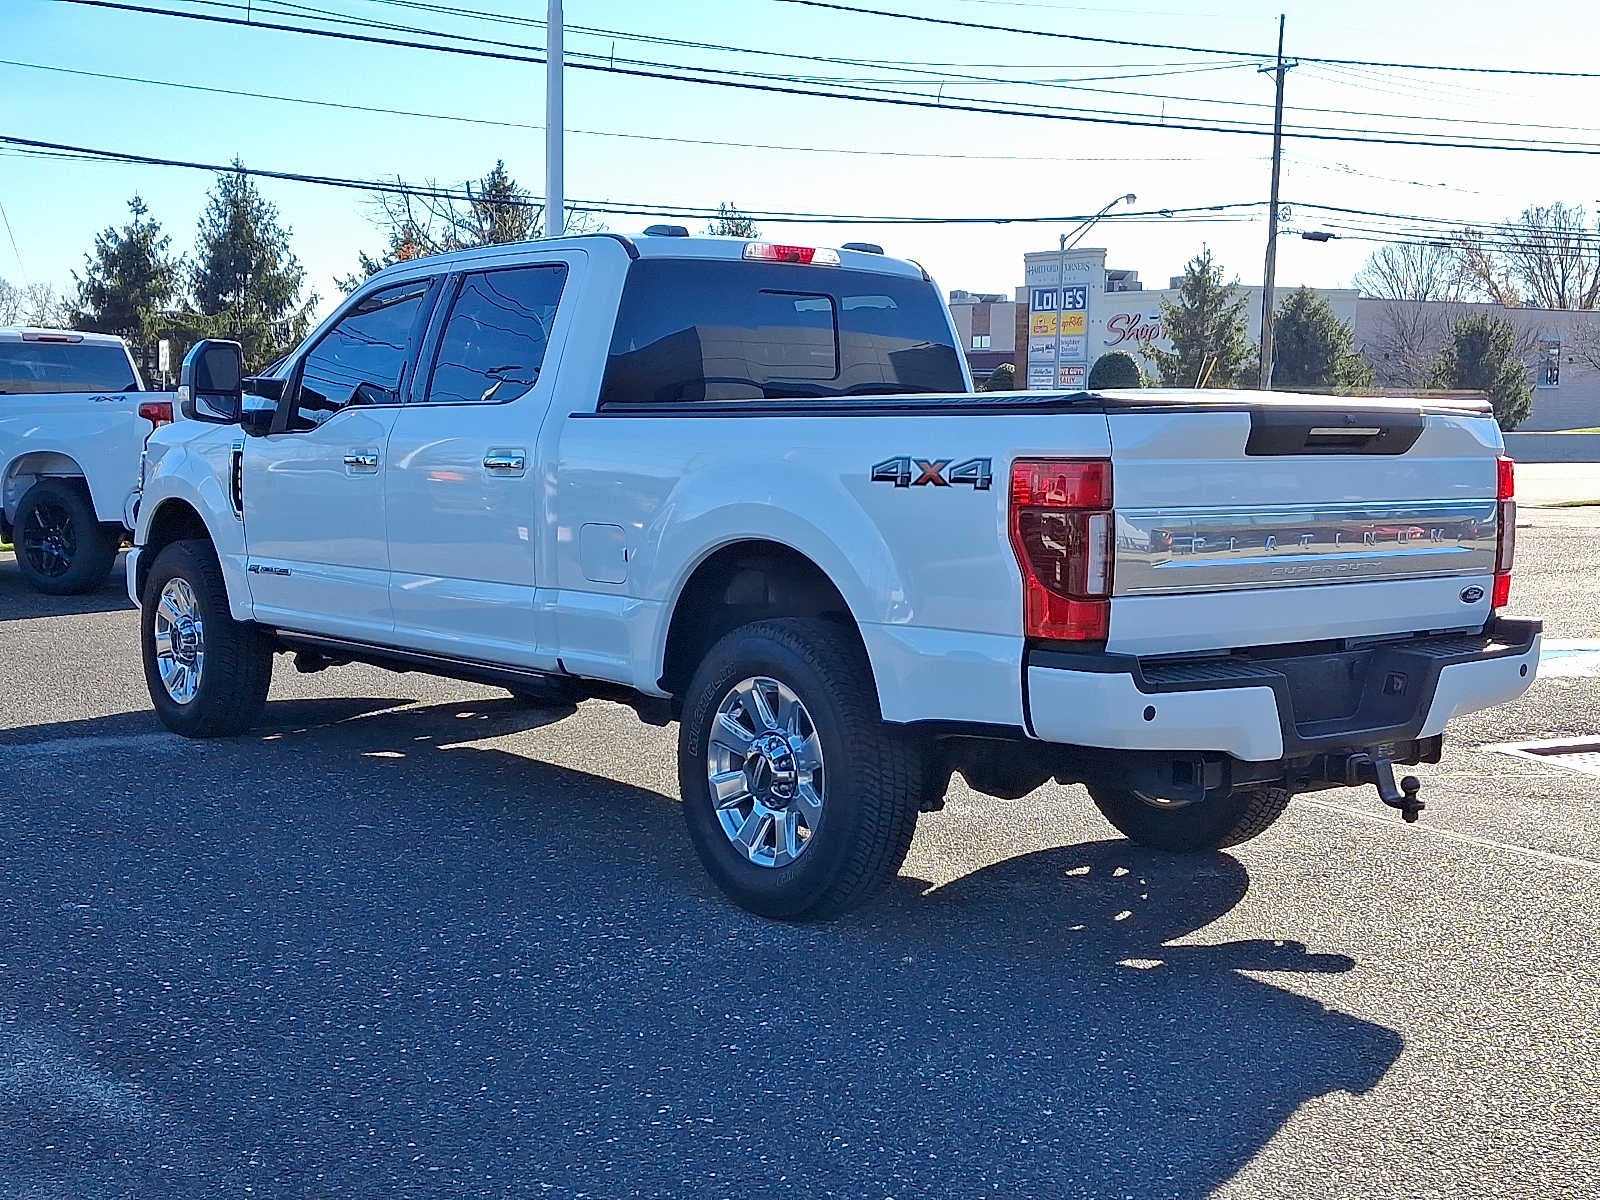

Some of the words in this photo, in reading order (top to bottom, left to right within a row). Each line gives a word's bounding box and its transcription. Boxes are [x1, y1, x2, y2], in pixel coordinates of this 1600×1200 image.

[1034, 288, 1084, 310] LOWE'S
[1193, 528, 1446, 554] PLATINUM
[1271, 564, 1333, 576] SUPER
